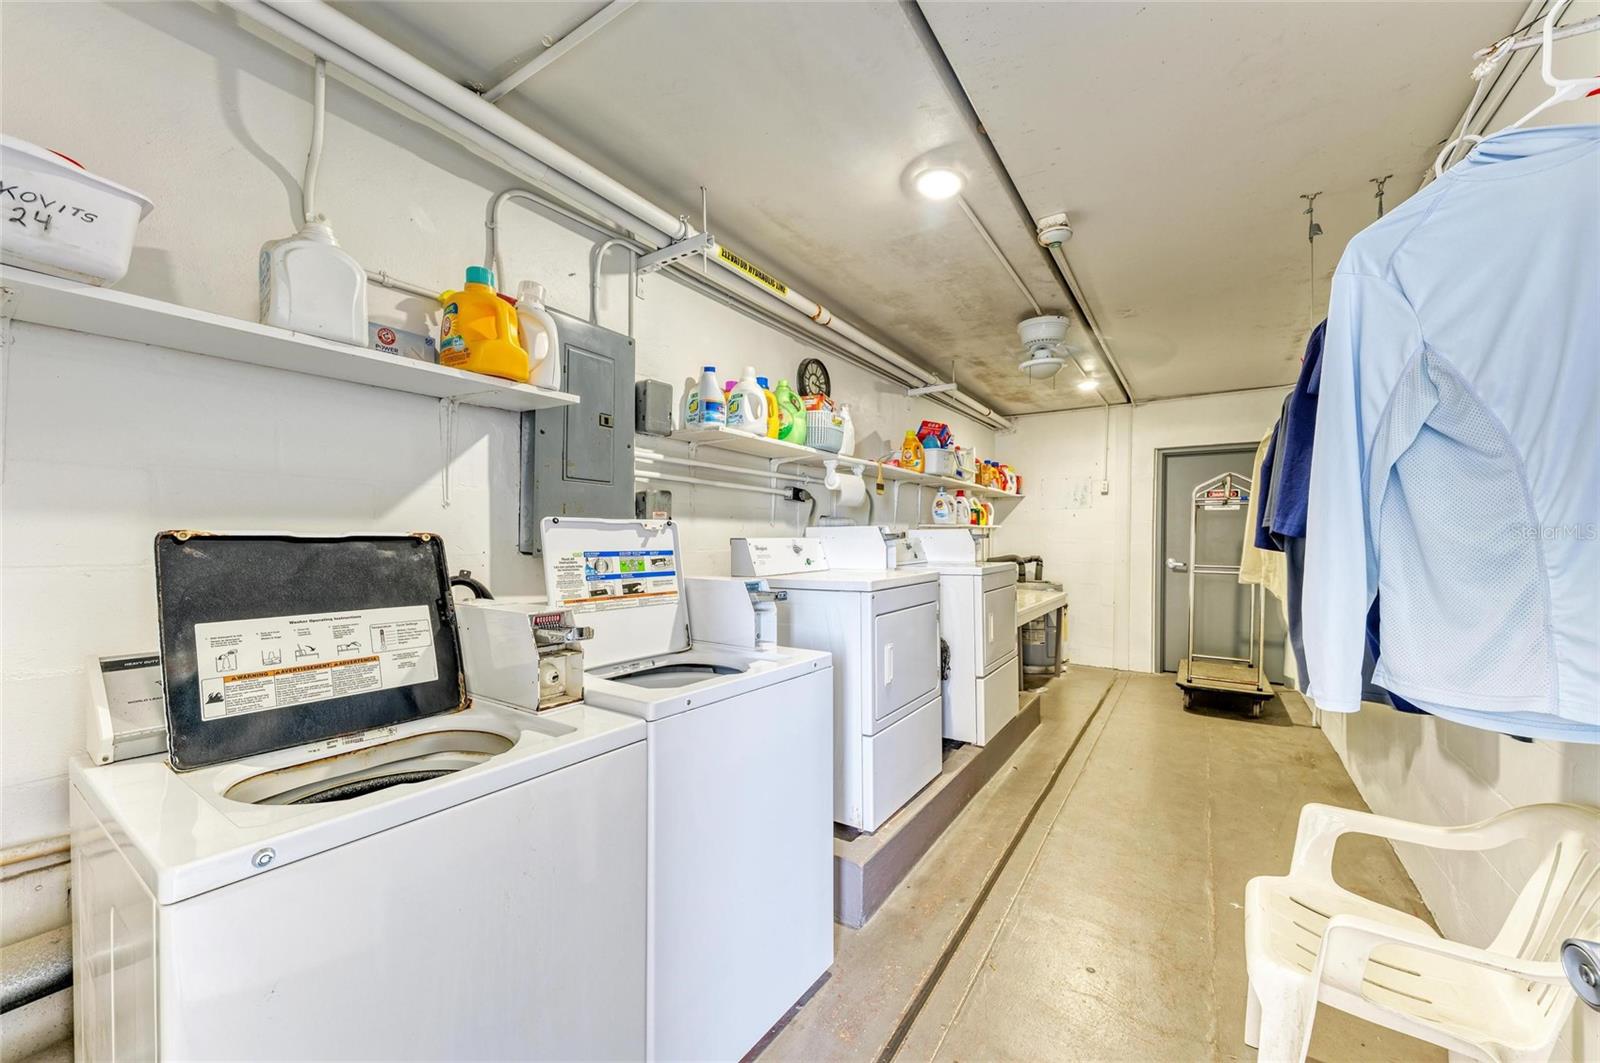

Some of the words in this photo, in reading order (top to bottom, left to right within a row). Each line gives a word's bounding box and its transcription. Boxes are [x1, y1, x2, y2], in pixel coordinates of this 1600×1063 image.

[9, 207, 53, 231] 24
[721, 248, 748, 271] ELEVATOR
[748, 265, 776, 288] HYDRAULIC
[775, 281, 786, 294] LINE
[237, 672, 268, 680] WARNING
[280, 663, 331, 674] AVERTISSEMENT
[337, 657, 377, 667] ADVERTENCIA
